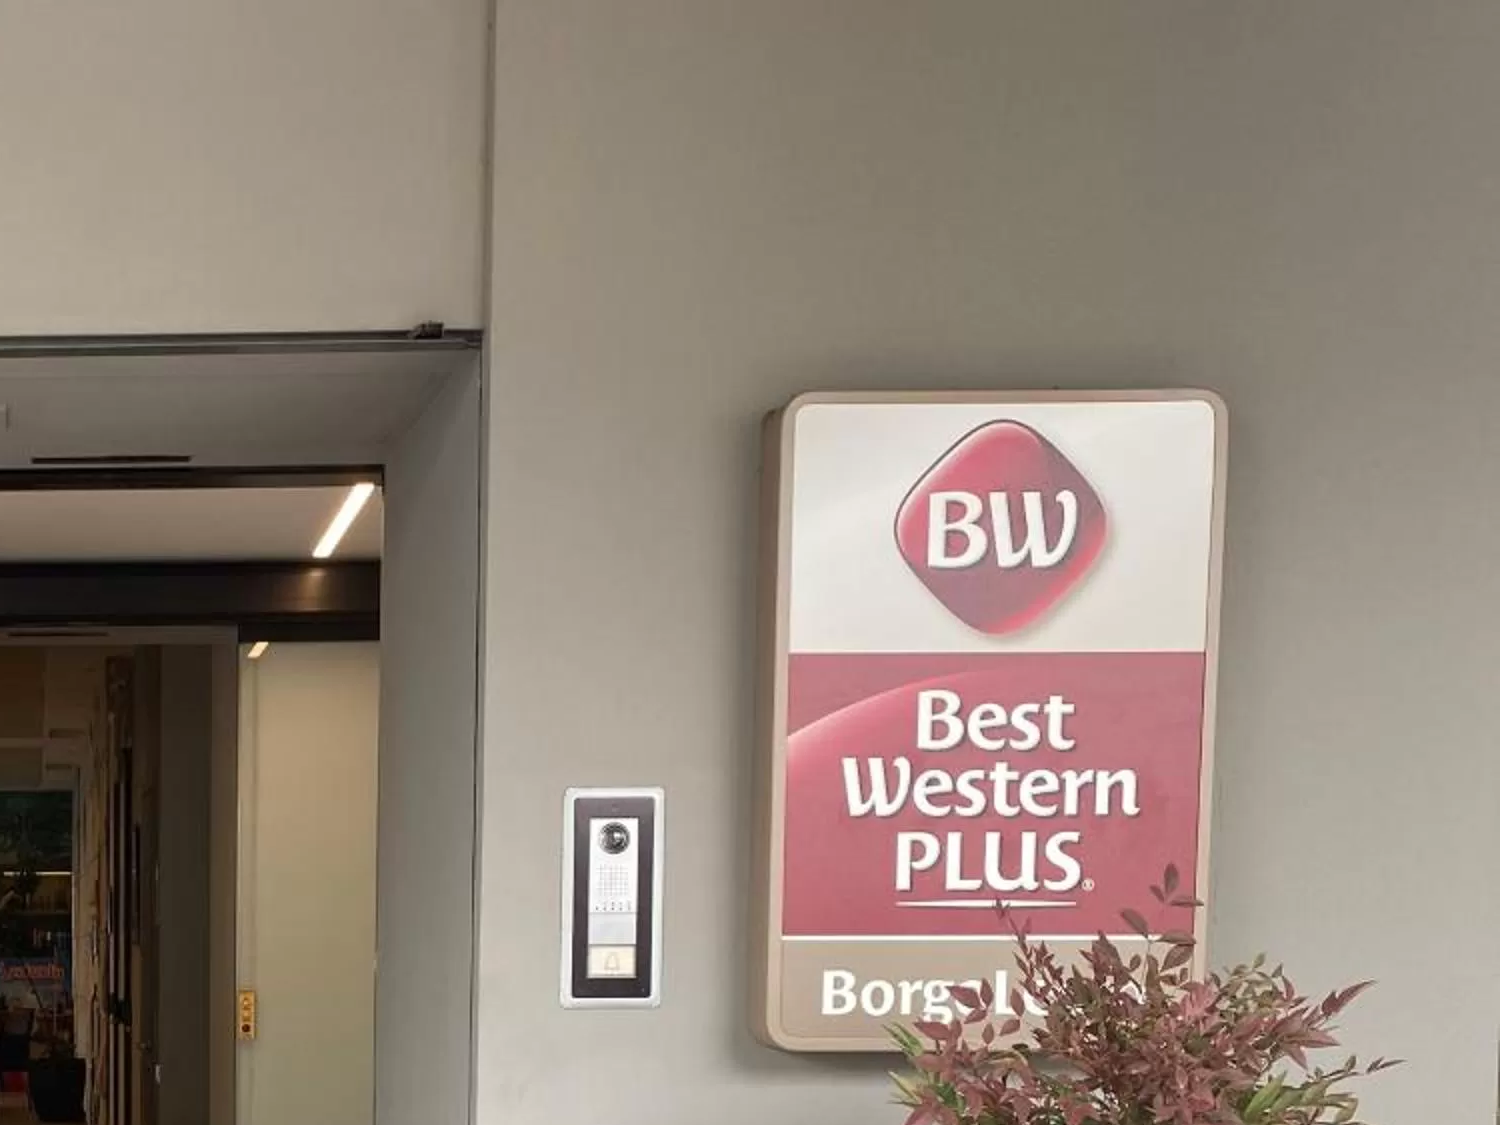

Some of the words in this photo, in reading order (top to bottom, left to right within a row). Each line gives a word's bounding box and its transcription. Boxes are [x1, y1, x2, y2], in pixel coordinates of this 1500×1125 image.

[928, 490, 1077, 569] BW
[916, 689, 1076, 751] Best
[841, 756, 1141, 818] Western
